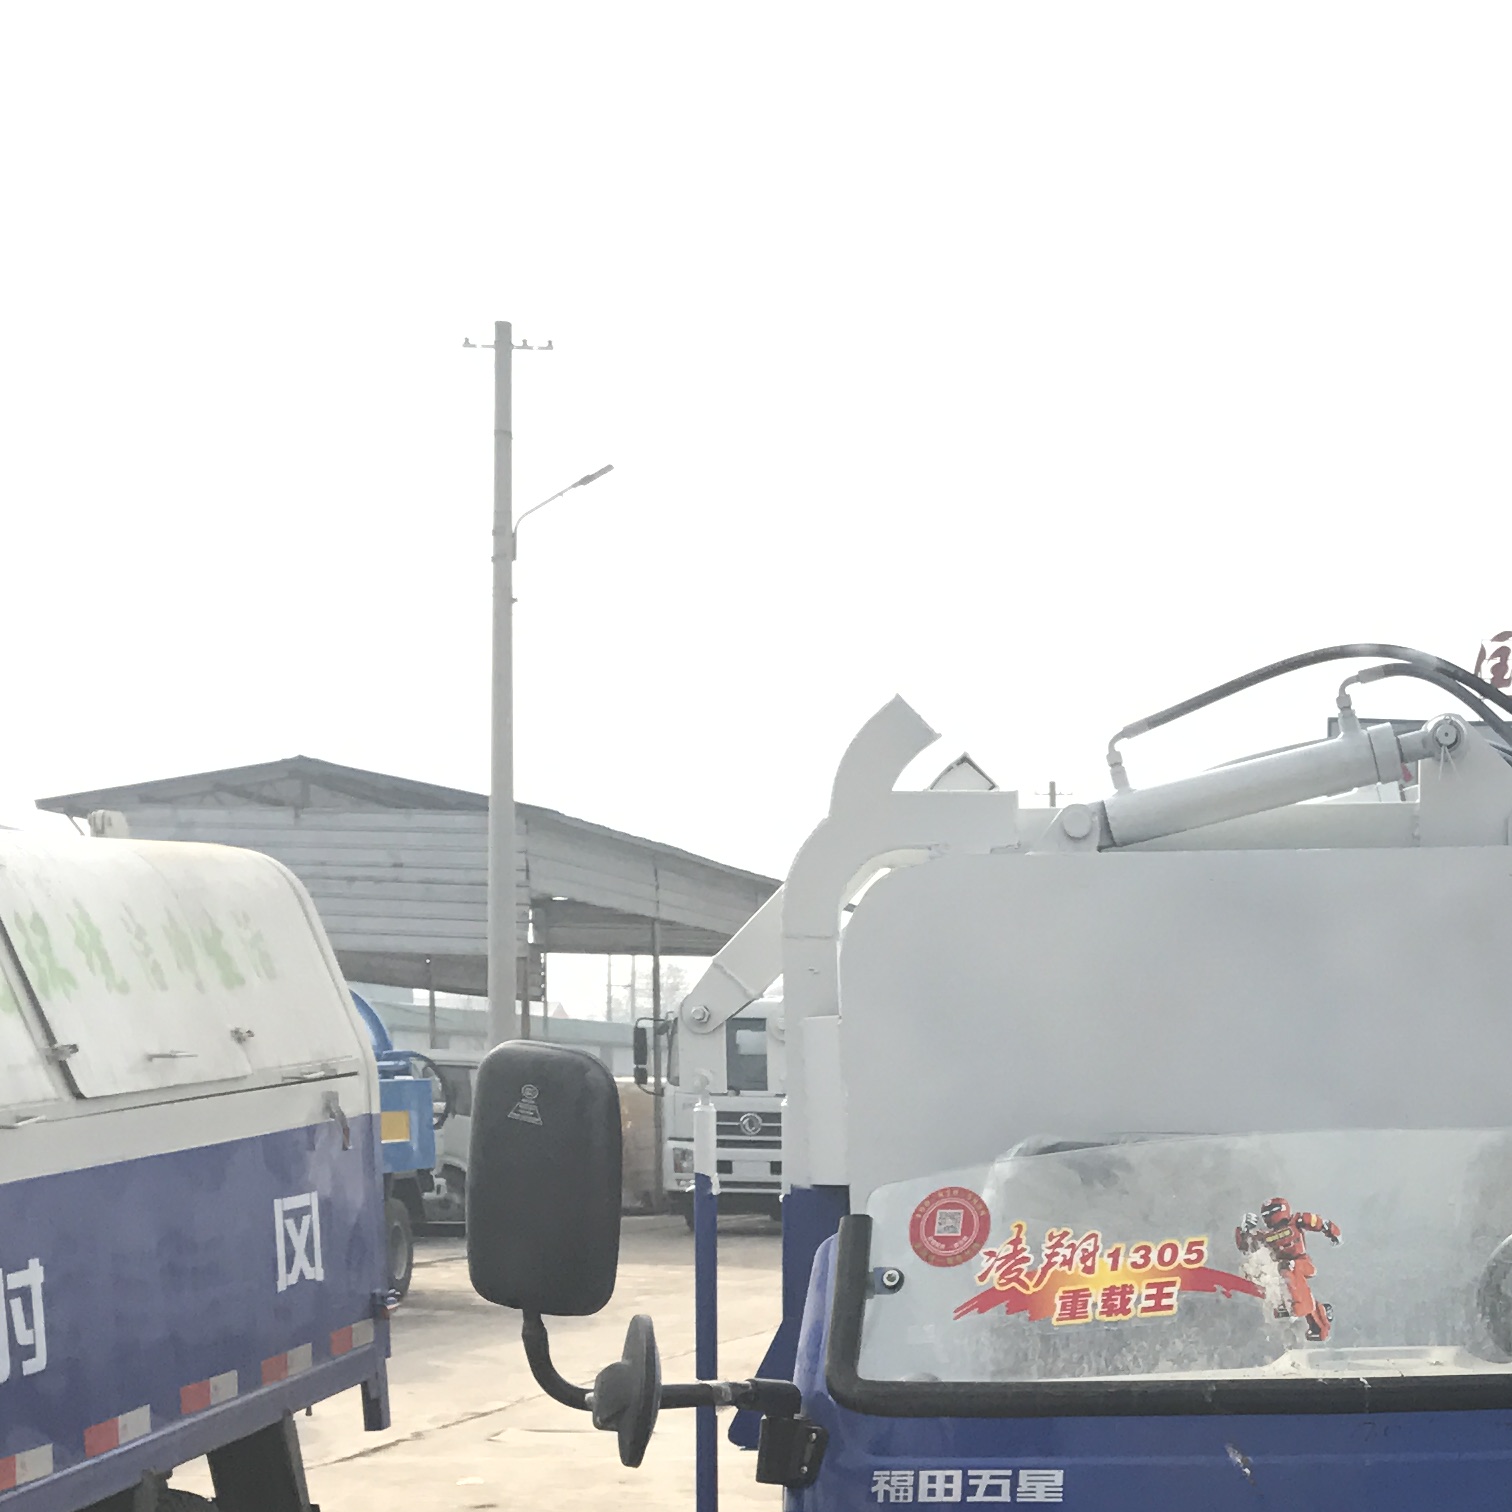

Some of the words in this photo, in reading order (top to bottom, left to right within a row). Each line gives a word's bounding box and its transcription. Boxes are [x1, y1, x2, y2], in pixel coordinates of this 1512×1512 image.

[1055, 1280, 1177, 1322] 重载王
[870, 1469, 1064, 1503] 福田五星
